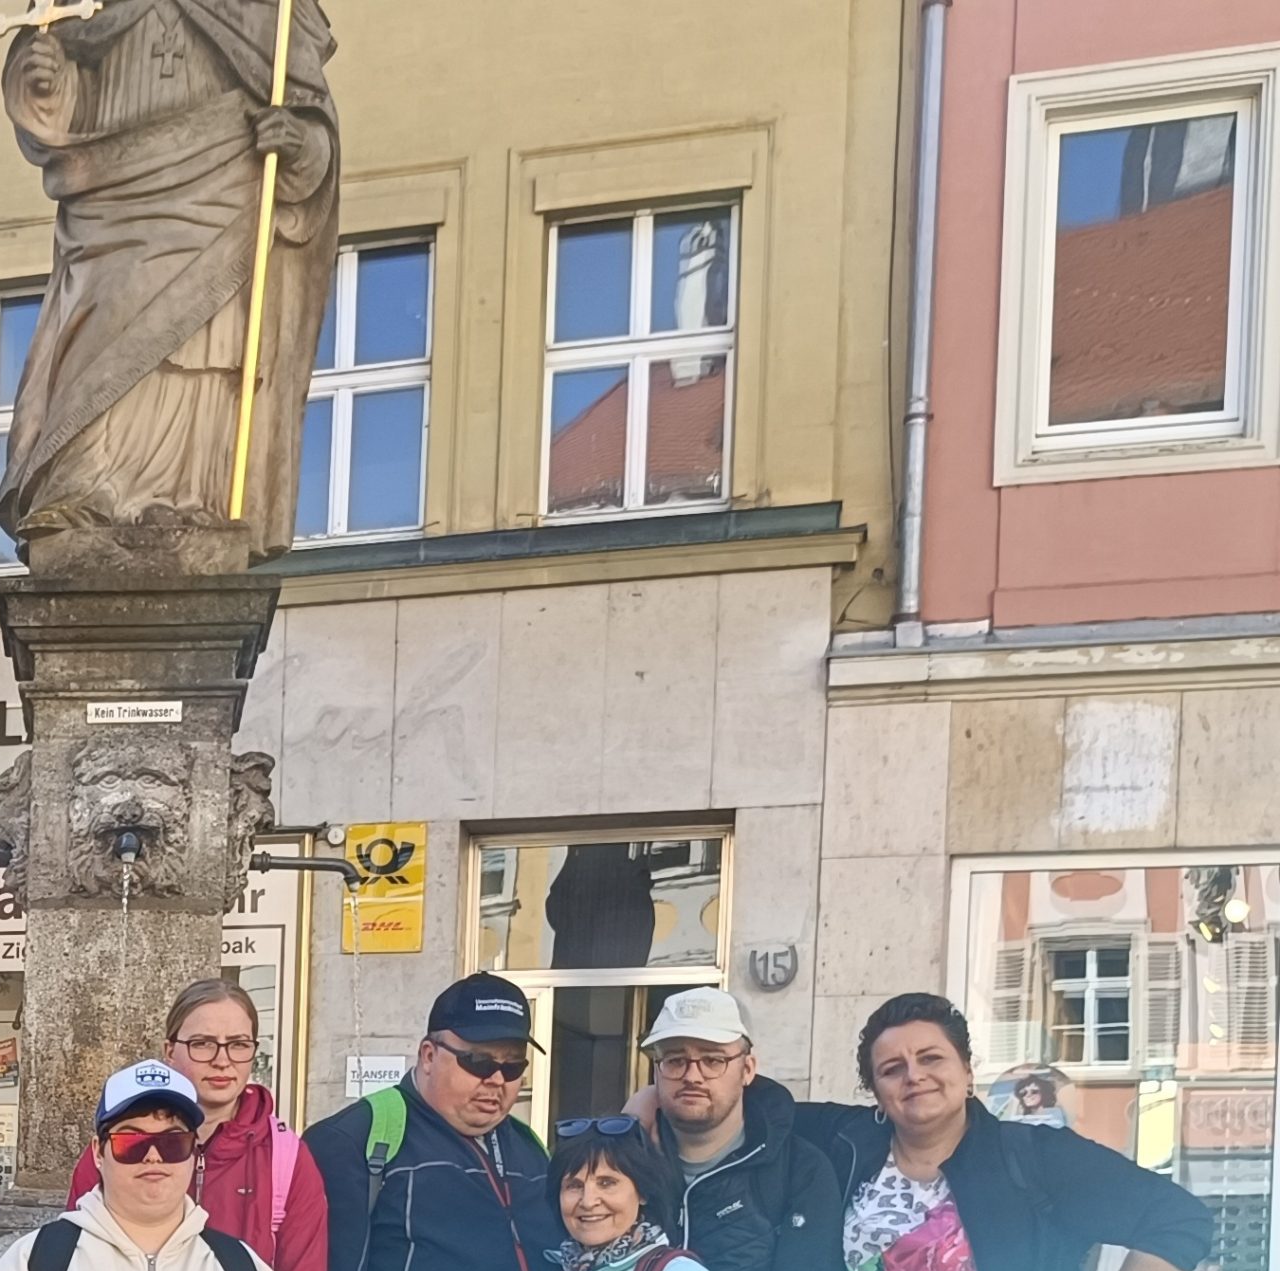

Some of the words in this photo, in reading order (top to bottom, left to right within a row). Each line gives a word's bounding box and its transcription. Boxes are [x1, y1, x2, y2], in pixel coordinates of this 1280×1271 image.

[94, 707, 114, 718] Kein
[117, 706, 174, 718] Trinkwasser
[360, 921, 404, 932] DHL
[757, 950, 790, 987] 15
